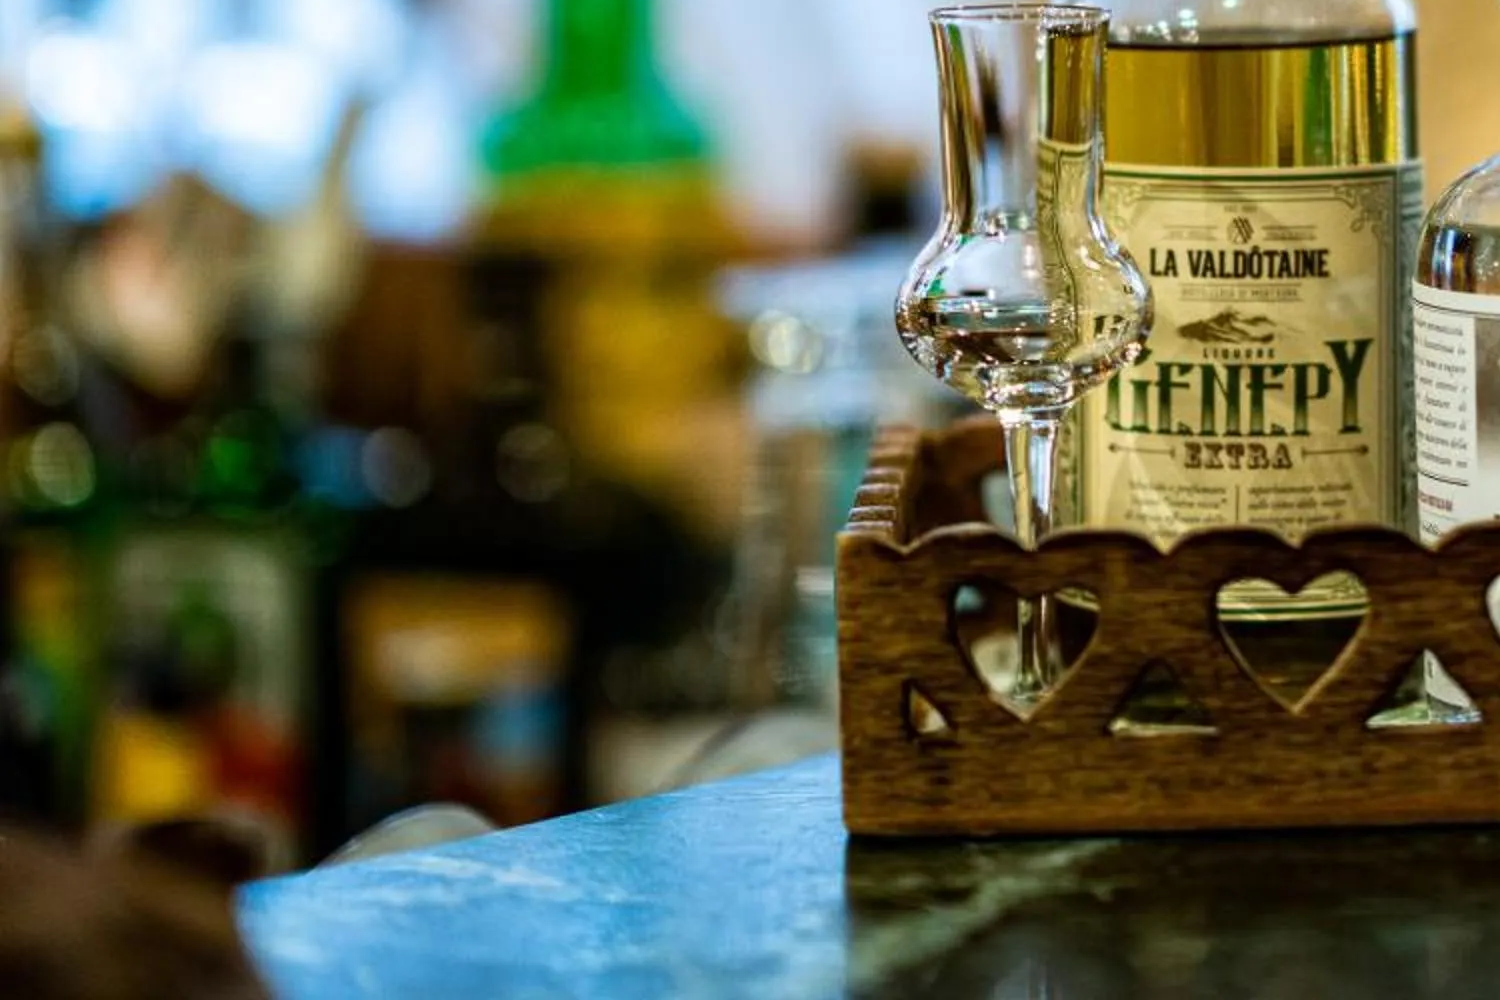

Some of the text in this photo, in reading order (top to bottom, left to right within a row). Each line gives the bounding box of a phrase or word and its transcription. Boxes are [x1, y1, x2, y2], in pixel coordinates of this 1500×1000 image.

[1150, 246, 1330, 279] LA VALDÔTAINE
[1105, 338, 1374, 436] GENEPY
[1184, 442, 1293, 469] EXTRA
